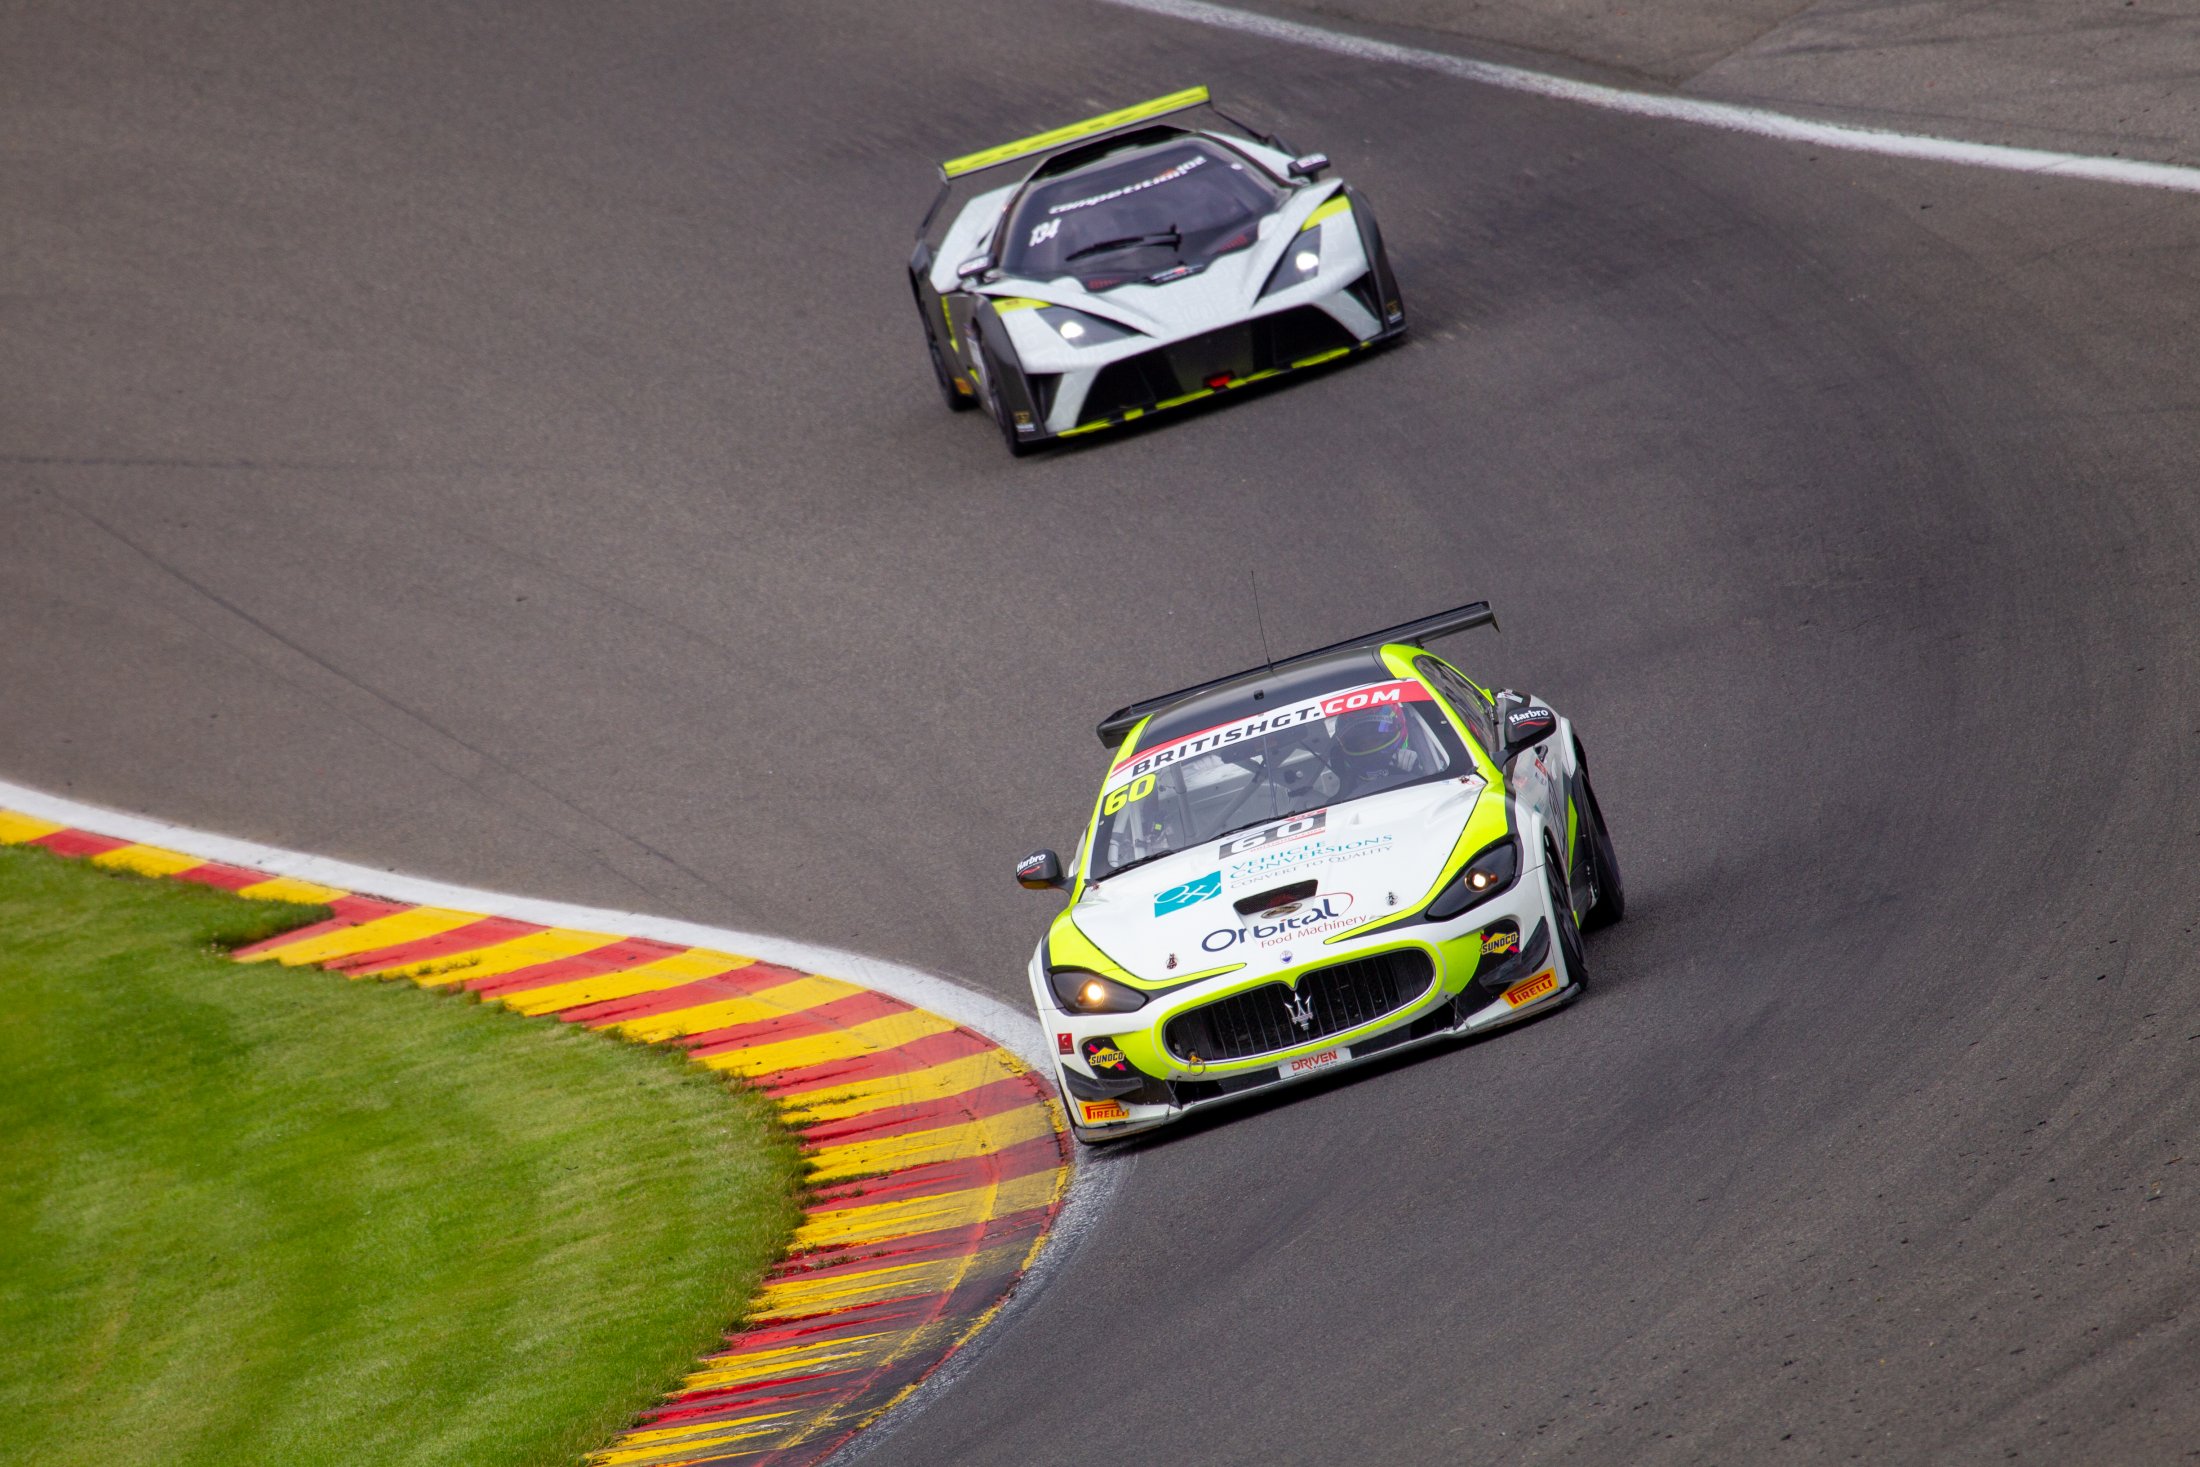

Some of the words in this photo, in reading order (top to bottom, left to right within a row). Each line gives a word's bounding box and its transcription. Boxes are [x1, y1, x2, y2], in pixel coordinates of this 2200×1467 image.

[1029, 217, 1062, 247] 134
[1508, 709, 1549, 724] Harbro
[1132, 688, 1401, 778] BRITISHGT.COM
[1103, 773, 1157, 816] 60
[1231, 817, 1315, 854] 60
[1016, 854, 1046, 872] Harbro
[1230, 834, 1393, 879] CONVERSIONS
[1230, 867, 1297, 889] CONVERT
[1306, 859, 1324, 869] TO
[1328, 845, 1393, 864] QUALITY
[1232, 842, 1326, 870] VEHICLE
[1201, 898, 1339, 953] Orbital
[1261, 932, 1293, 949] Food
[1297, 914, 1367, 939] Machinery
[1482, 932, 1517, 955] SUNOCO
[1506, 973, 1553, 1005] PIRELLI
[1090, 1051, 1124, 1065] SUNOCO
[1290, 1049, 1338, 1071] DRIVEN
